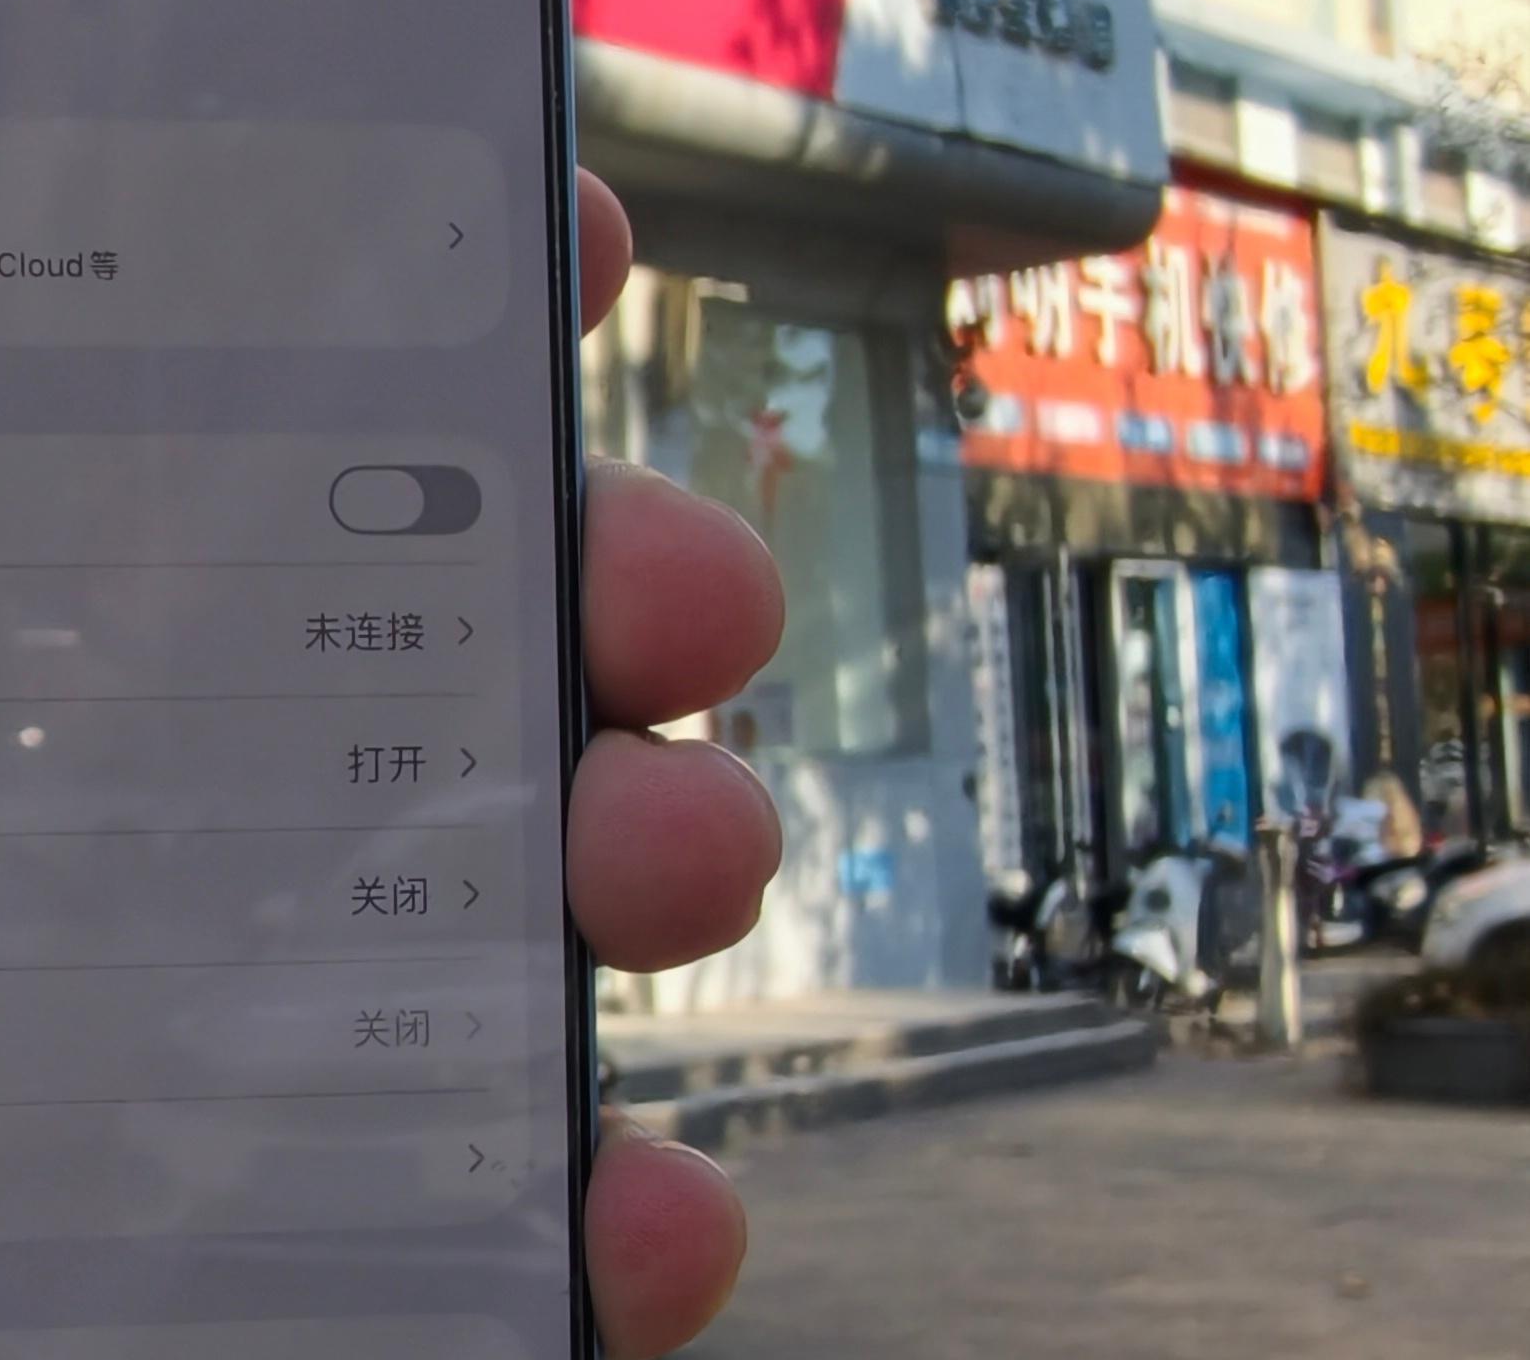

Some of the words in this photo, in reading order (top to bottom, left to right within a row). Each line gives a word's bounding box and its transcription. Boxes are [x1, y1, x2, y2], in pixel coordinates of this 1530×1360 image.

[305, 611, 425, 653] 未连接
[347, 744, 427, 784] 打开
[351, 875, 428, 916] 关闭
[353, 1009, 430, 1049] 关闭
